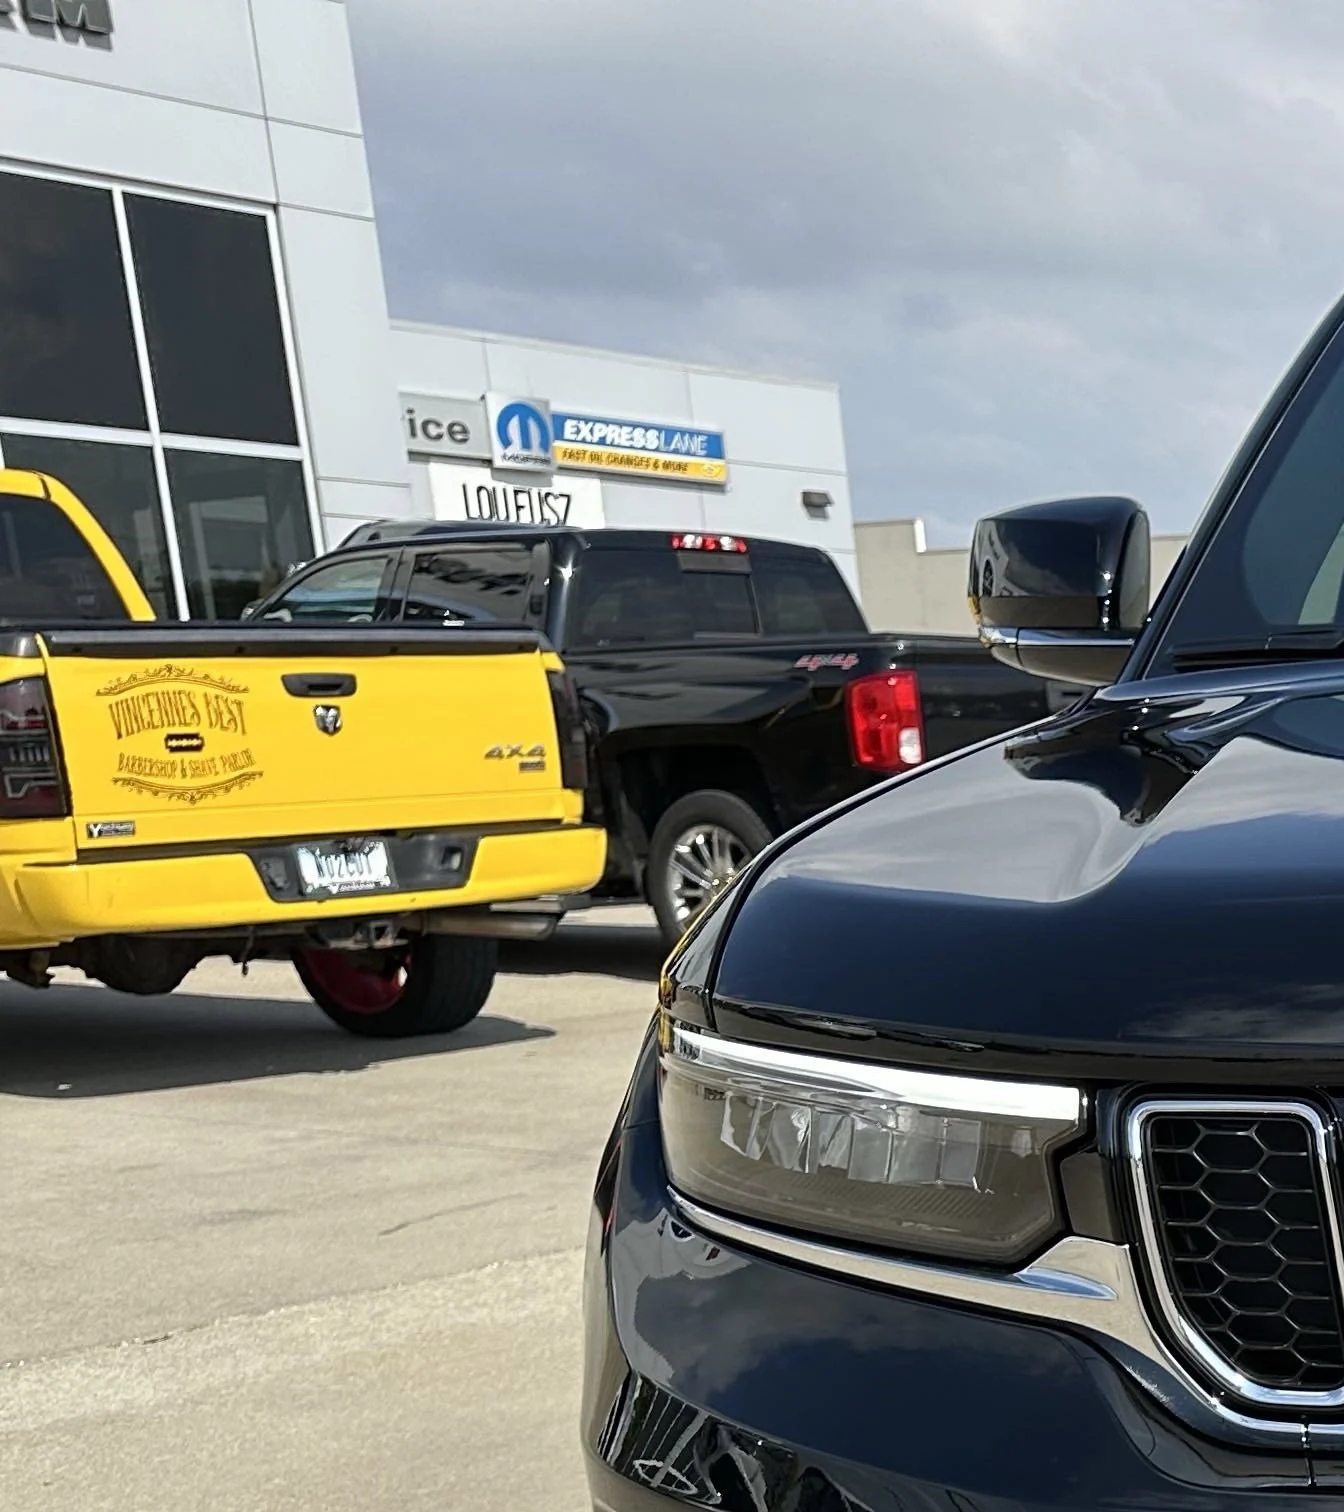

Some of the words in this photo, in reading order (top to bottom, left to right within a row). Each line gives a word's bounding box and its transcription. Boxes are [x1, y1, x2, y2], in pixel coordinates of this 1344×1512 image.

[562, 448, 586, 464] FAST
[606, 452, 651, 470] CHANGES
[661, 459, 689, 473] MORE
[462, 483, 510, 521] LOU
[108, 690, 201, 740] VINCENNES
[203, 692, 247, 736] BEST
[117, 752, 177, 779] BARBERSHOP
[220, 748, 257, 773] PARLOR
